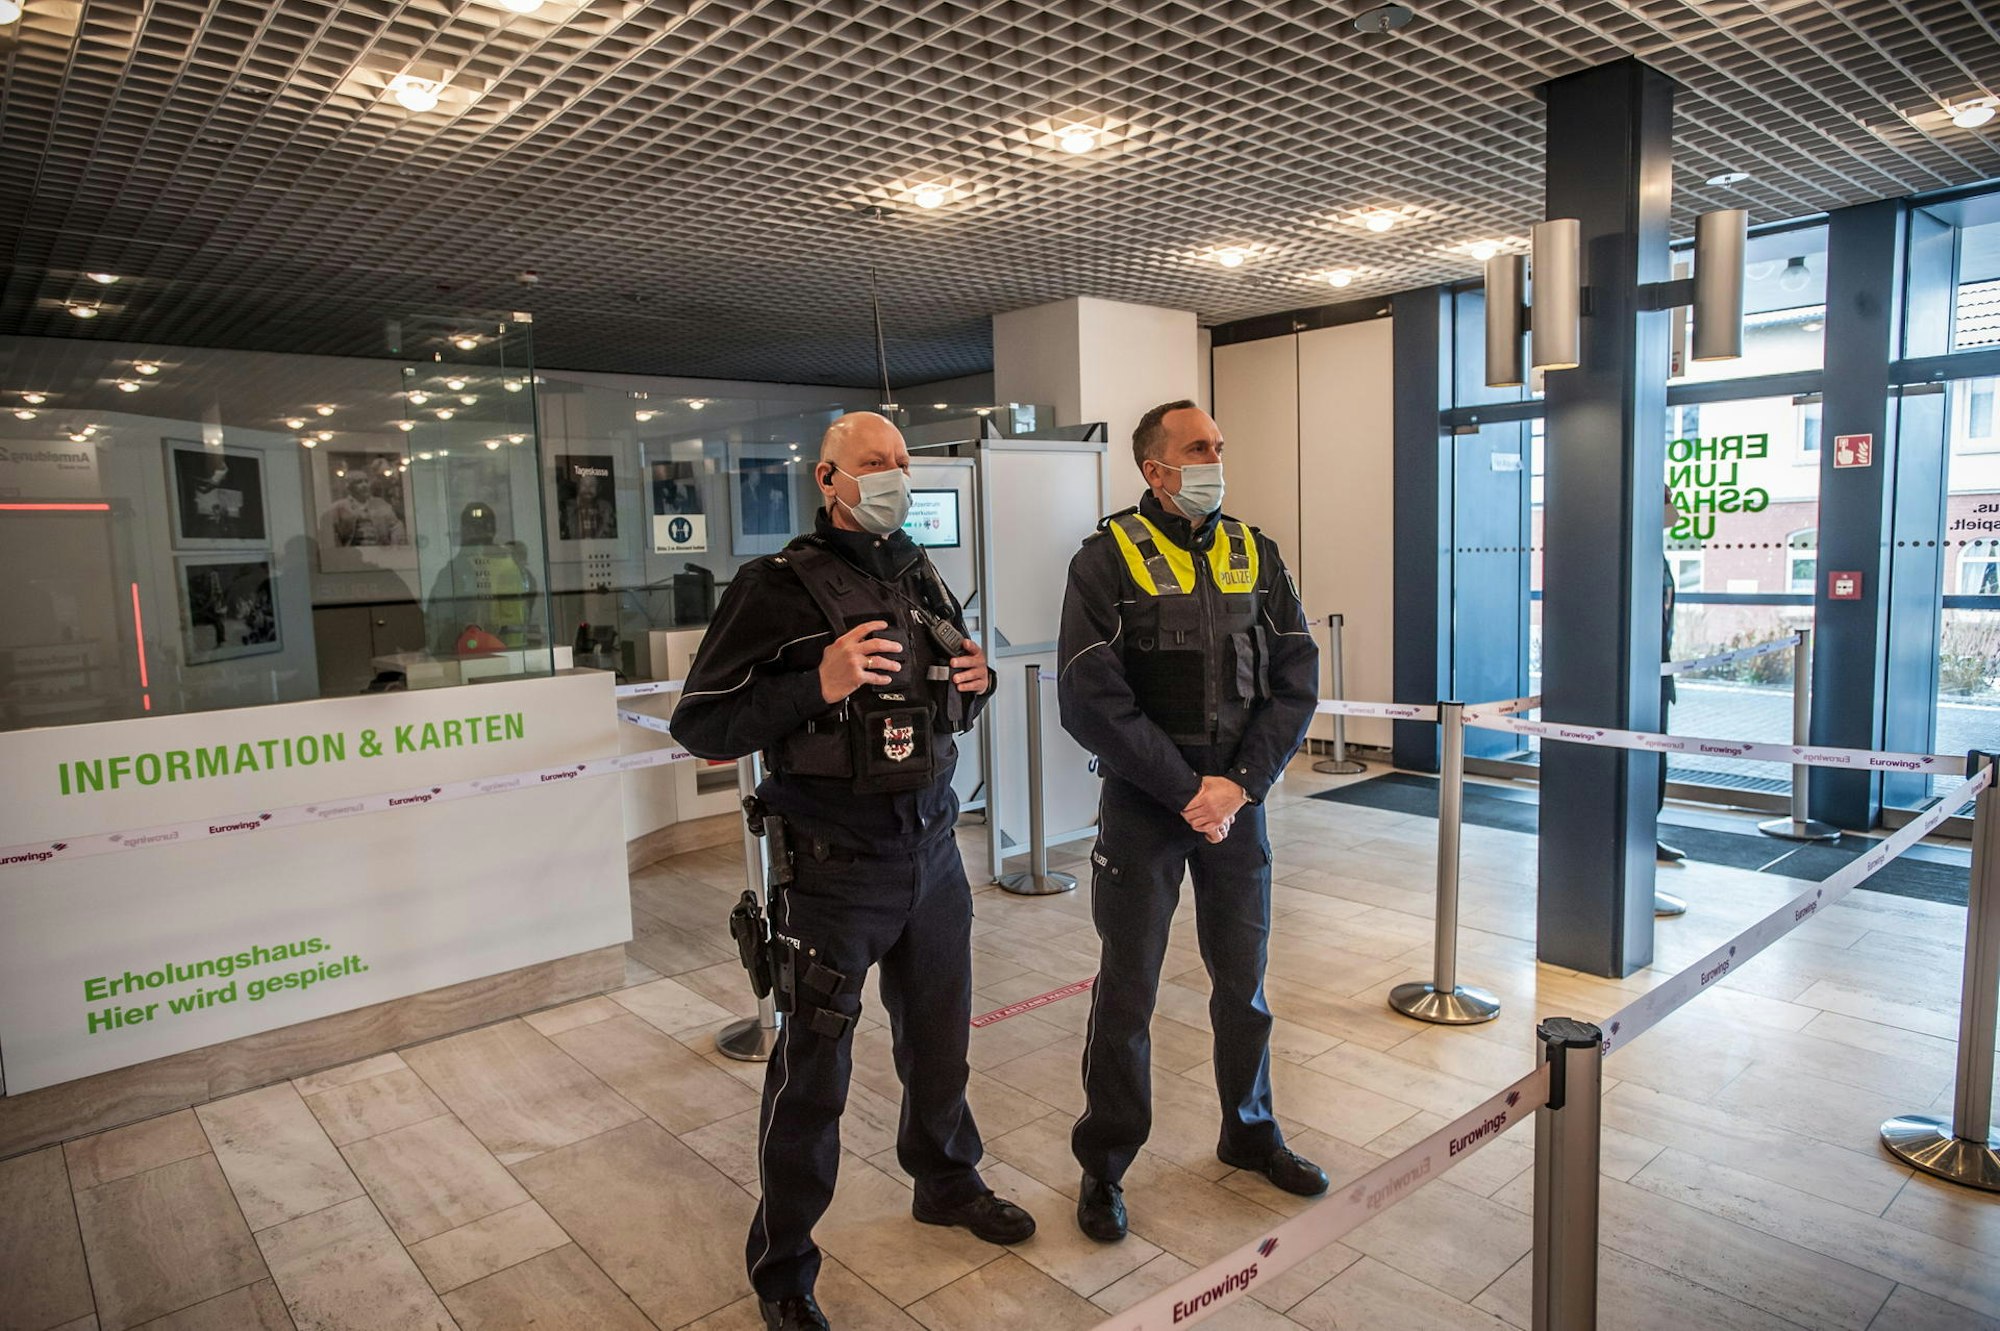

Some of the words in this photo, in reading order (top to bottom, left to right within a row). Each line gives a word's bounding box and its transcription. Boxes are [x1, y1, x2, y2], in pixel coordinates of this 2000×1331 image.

[1385, 709, 1414, 717] Eurowings
[1560, 730, 1595, 741] Eurowings
[59, 732, 346, 796] INFORMATION
[358, 728, 383, 759] &
[394, 711, 525, 754] KARTEN
[1700, 744, 1742, 756] Eurowings
[1869, 757, 1921, 770] Eurowings
[541, 770, 577, 782] Eurowings
[389, 793, 432, 807] Eurowings
[209, 820, 260, 835] Eurowings
[1795, 901, 1817, 922] Eurowings
[84, 937, 331, 1002] Erholungshaus.
[1701, 959, 1730, 986] Eurowings
[87, 1002, 159, 1034] Hier
[168, 980, 237, 1015] wird
[246, 954, 369, 1001] gespielt.
[1449, 1110, 1507, 1157] Eurowings
[1172, 1263, 1258, 1324] Eurowings
